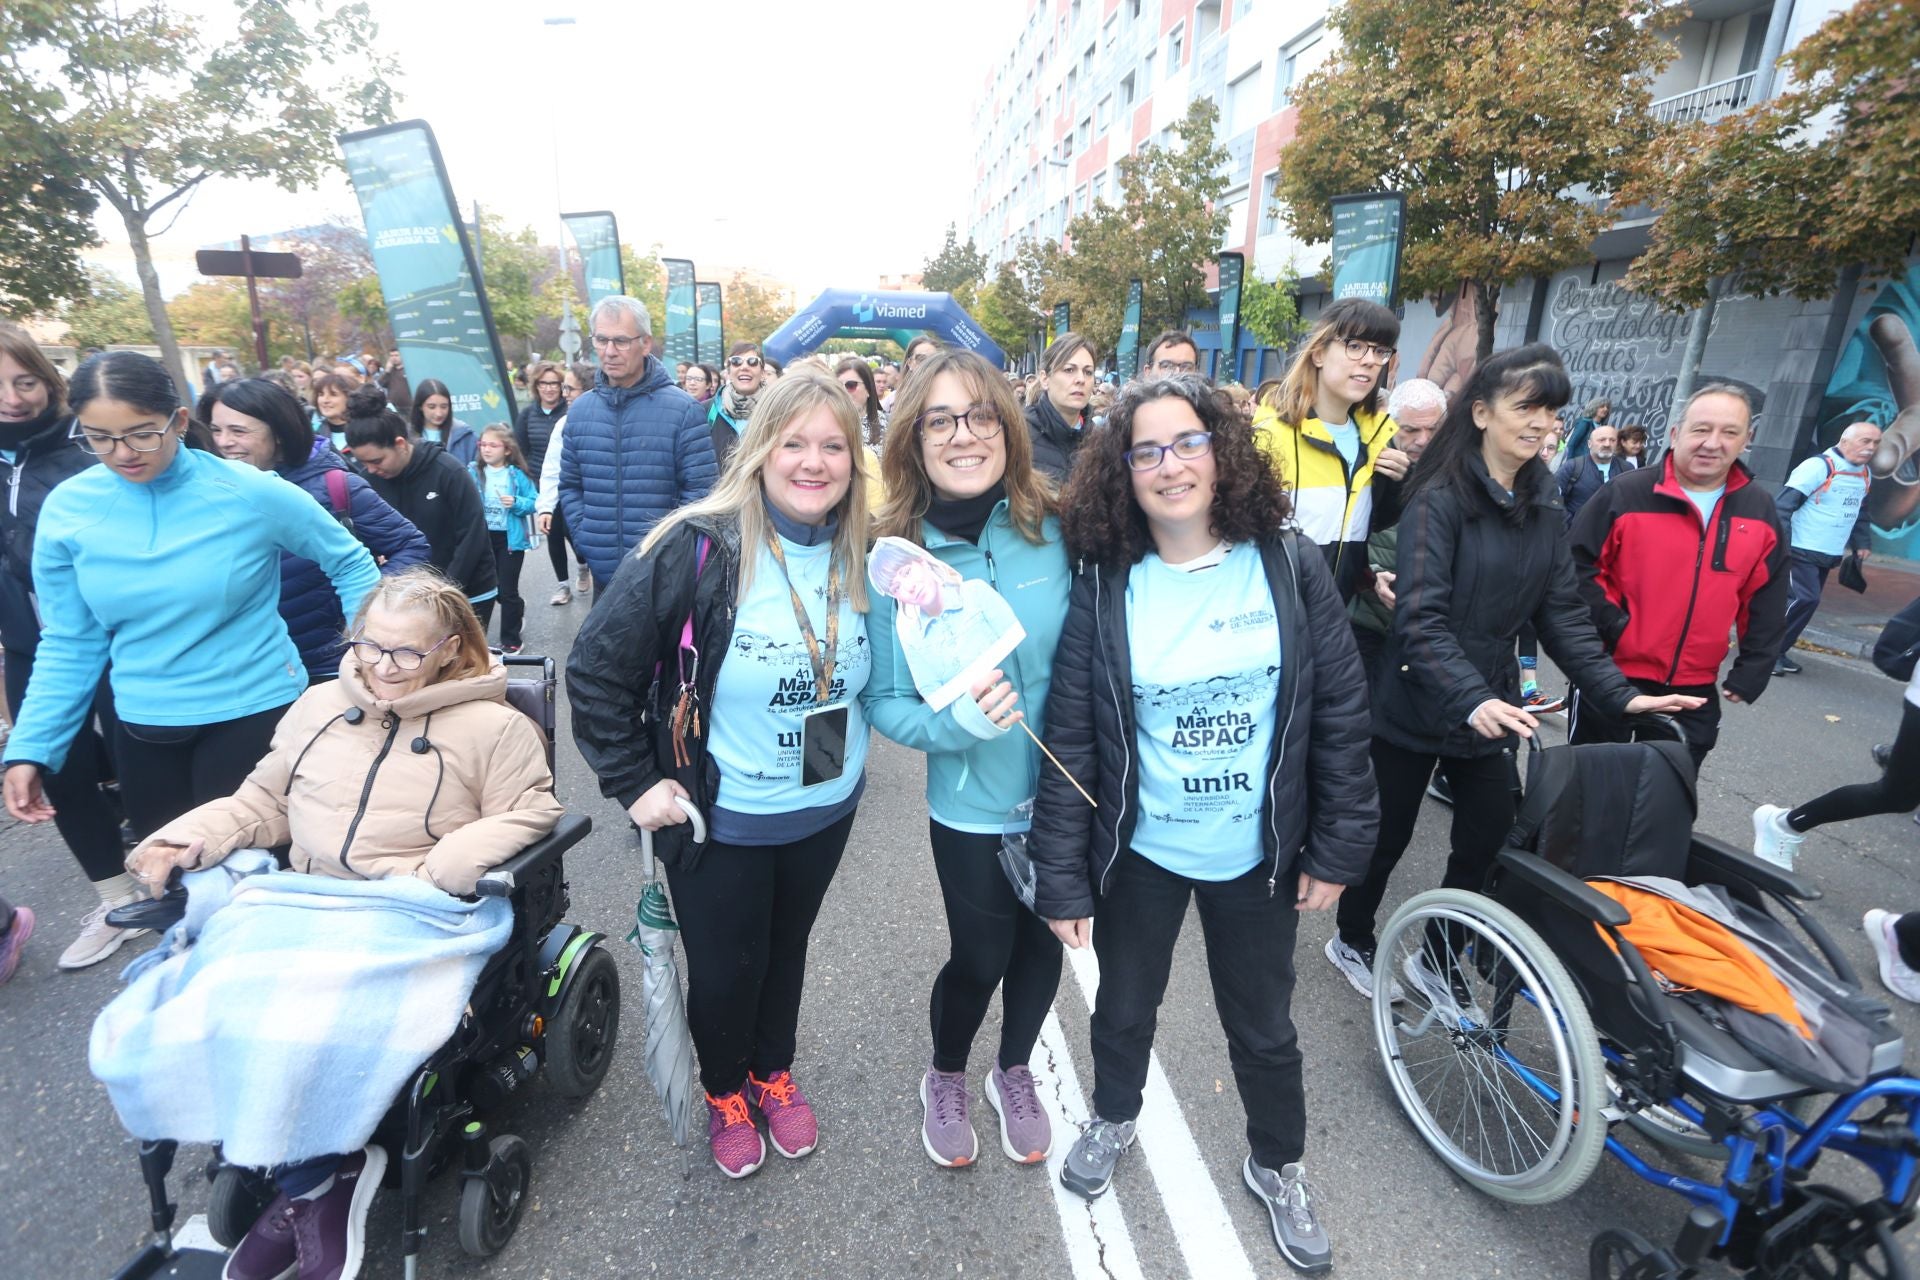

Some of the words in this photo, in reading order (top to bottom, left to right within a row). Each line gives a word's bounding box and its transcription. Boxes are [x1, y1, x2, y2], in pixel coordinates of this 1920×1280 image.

[876, 302, 926, 319] viamed
[795, 668, 810, 680] 41
[778, 677, 845, 692] Mara
[778, 706, 788, 714] de
[788, 703, 814, 714] octubre
[1176, 709, 1252, 730] Marcha
[1171, 723, 1257, 749] ASPACE
[1183, 794, 1230, 802] UNIVERSIDAD
[1183, 800, 1240, 808] INTERNACIONAL
